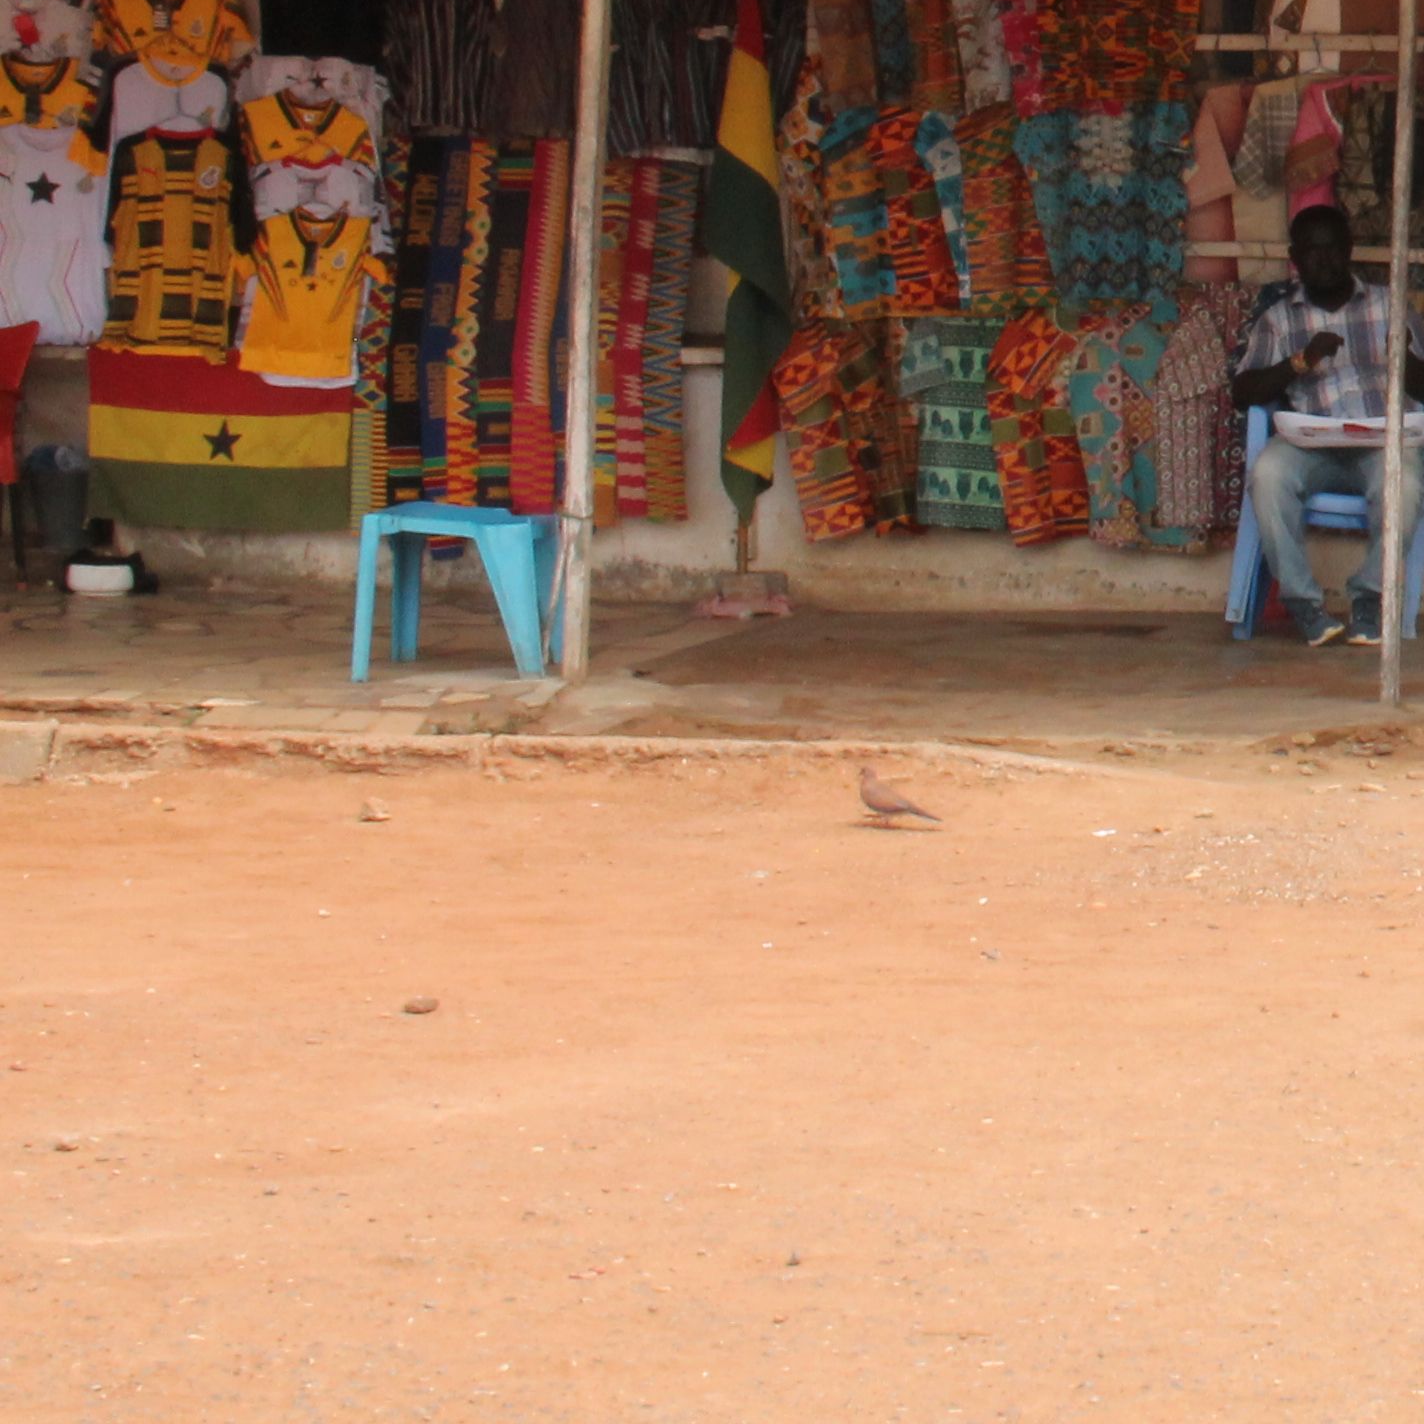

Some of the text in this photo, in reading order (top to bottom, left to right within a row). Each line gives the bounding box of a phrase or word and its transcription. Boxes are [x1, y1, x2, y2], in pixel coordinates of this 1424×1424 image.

[438, 151, 468, 247] GREETINGS
[393, 173, 438, 403] WELCOME TO GHANA
[427, 361, 446, 419] GHANA
